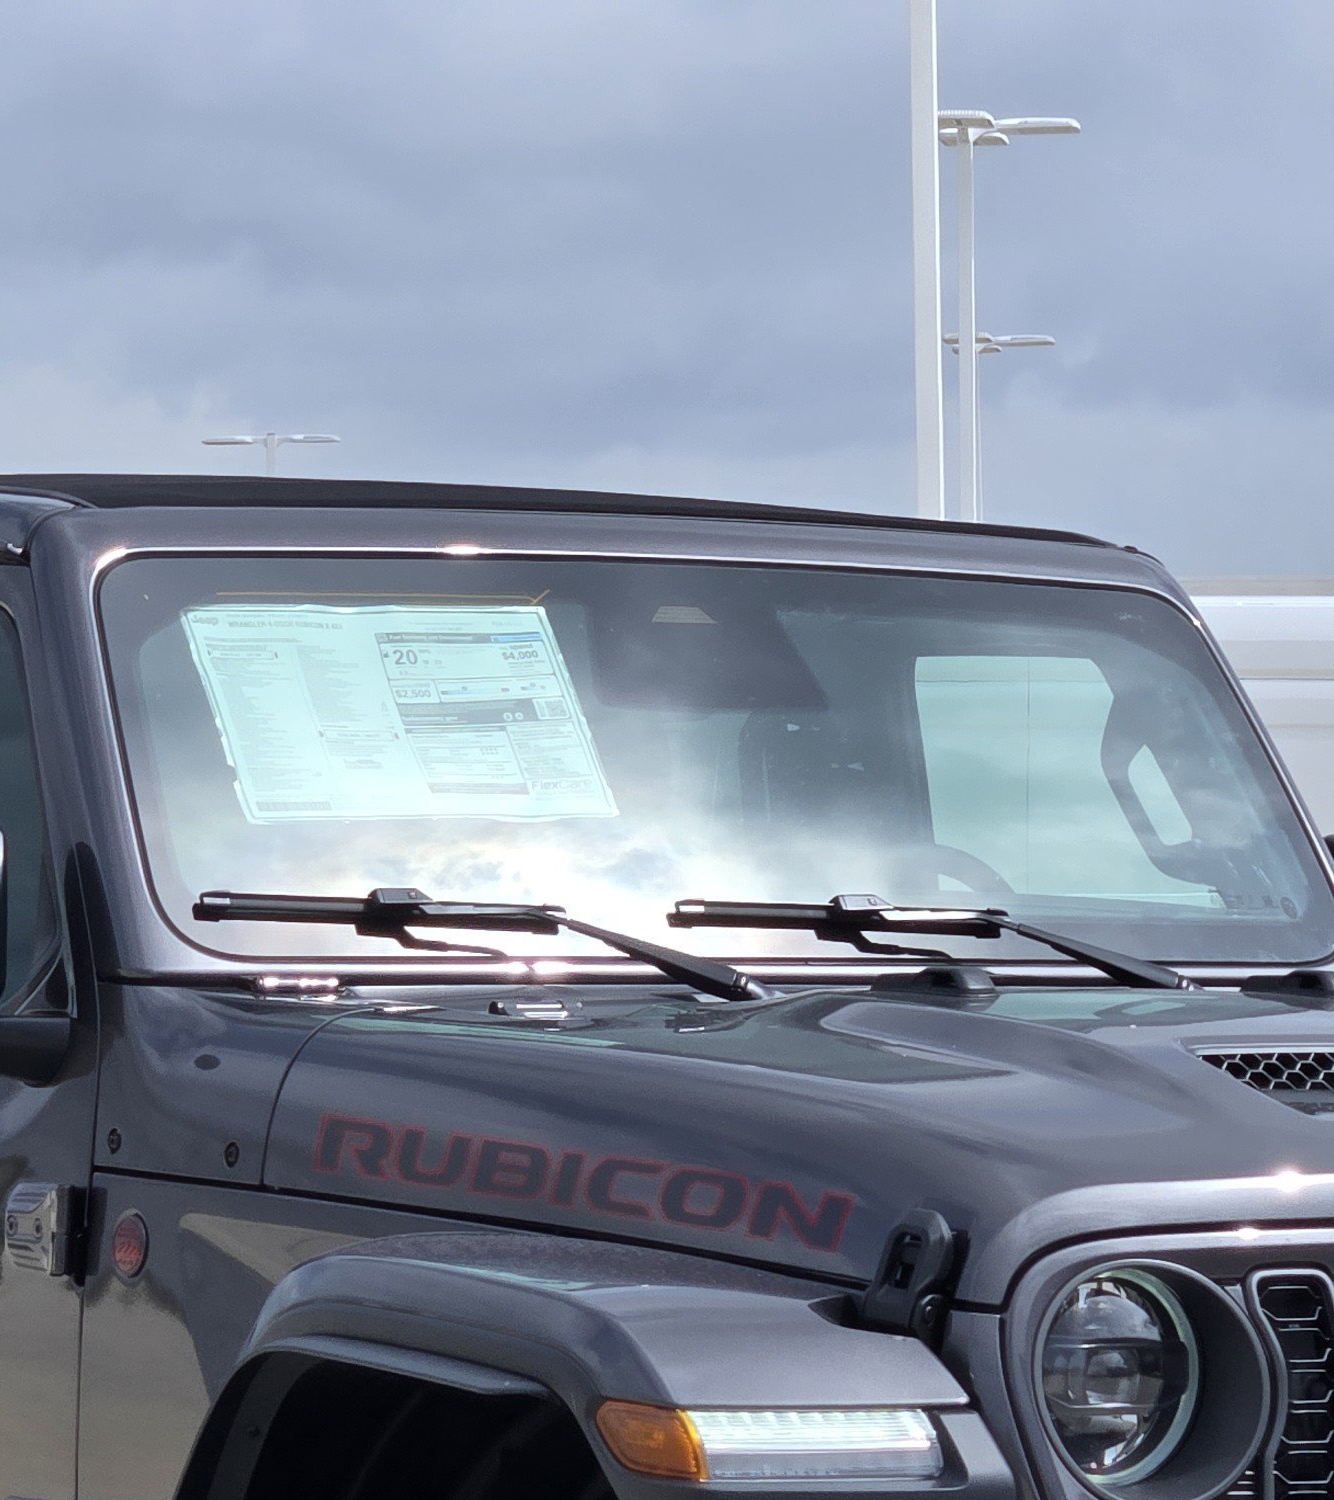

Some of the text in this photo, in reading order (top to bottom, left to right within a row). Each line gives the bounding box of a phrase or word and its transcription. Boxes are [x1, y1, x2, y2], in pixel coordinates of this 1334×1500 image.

[392, 648, 418, 666] 20
[502, 649, 539, 661] $4,000
[395, 689, 432, 699] $2,500
[531, 779, 592, 792] FlexCare
[312, 1112, 858, 1255] RUBICON
